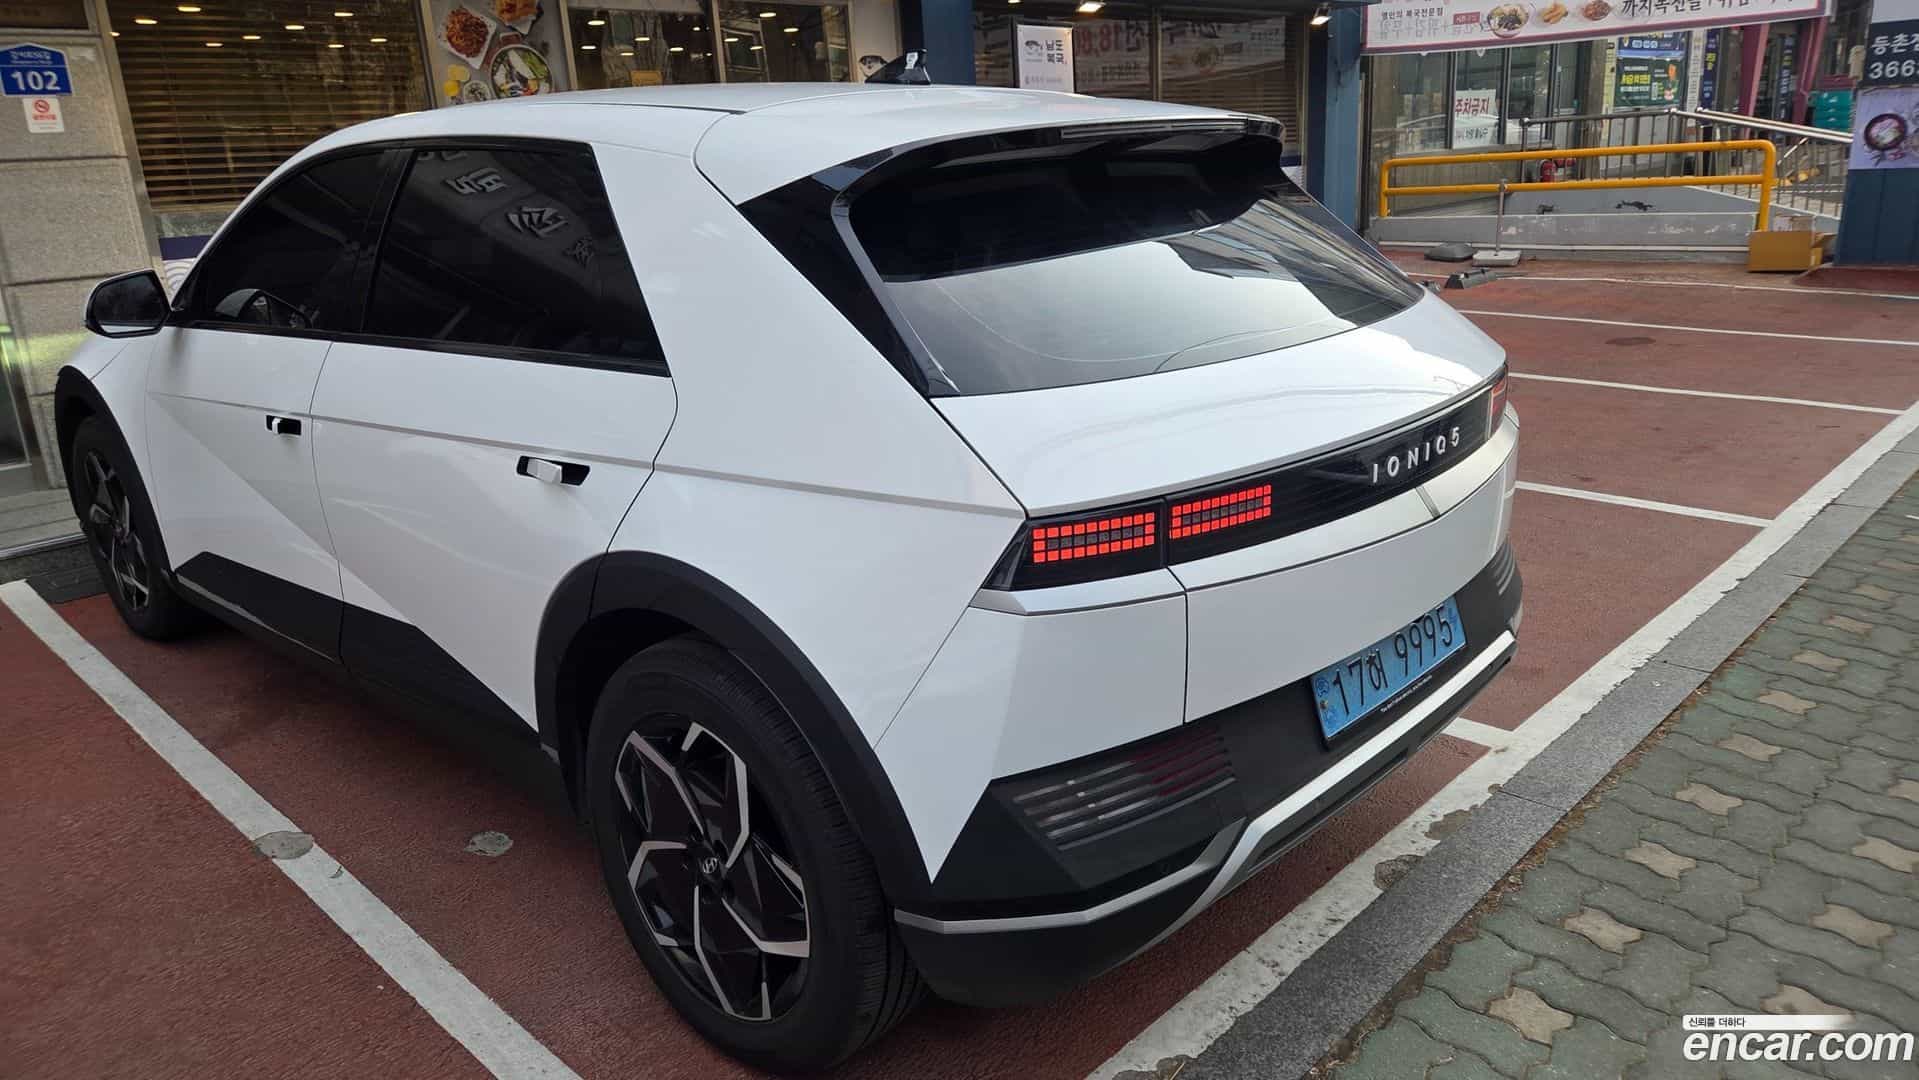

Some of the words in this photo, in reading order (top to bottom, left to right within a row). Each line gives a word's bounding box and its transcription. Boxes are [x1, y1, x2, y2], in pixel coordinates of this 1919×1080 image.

[1869, 59, 1919, 79] 366
[11, 71, 61, 91] 102
[1455, 96, 1489, 116] 주차금지
[1394, 603, 1453, 678] 9995
